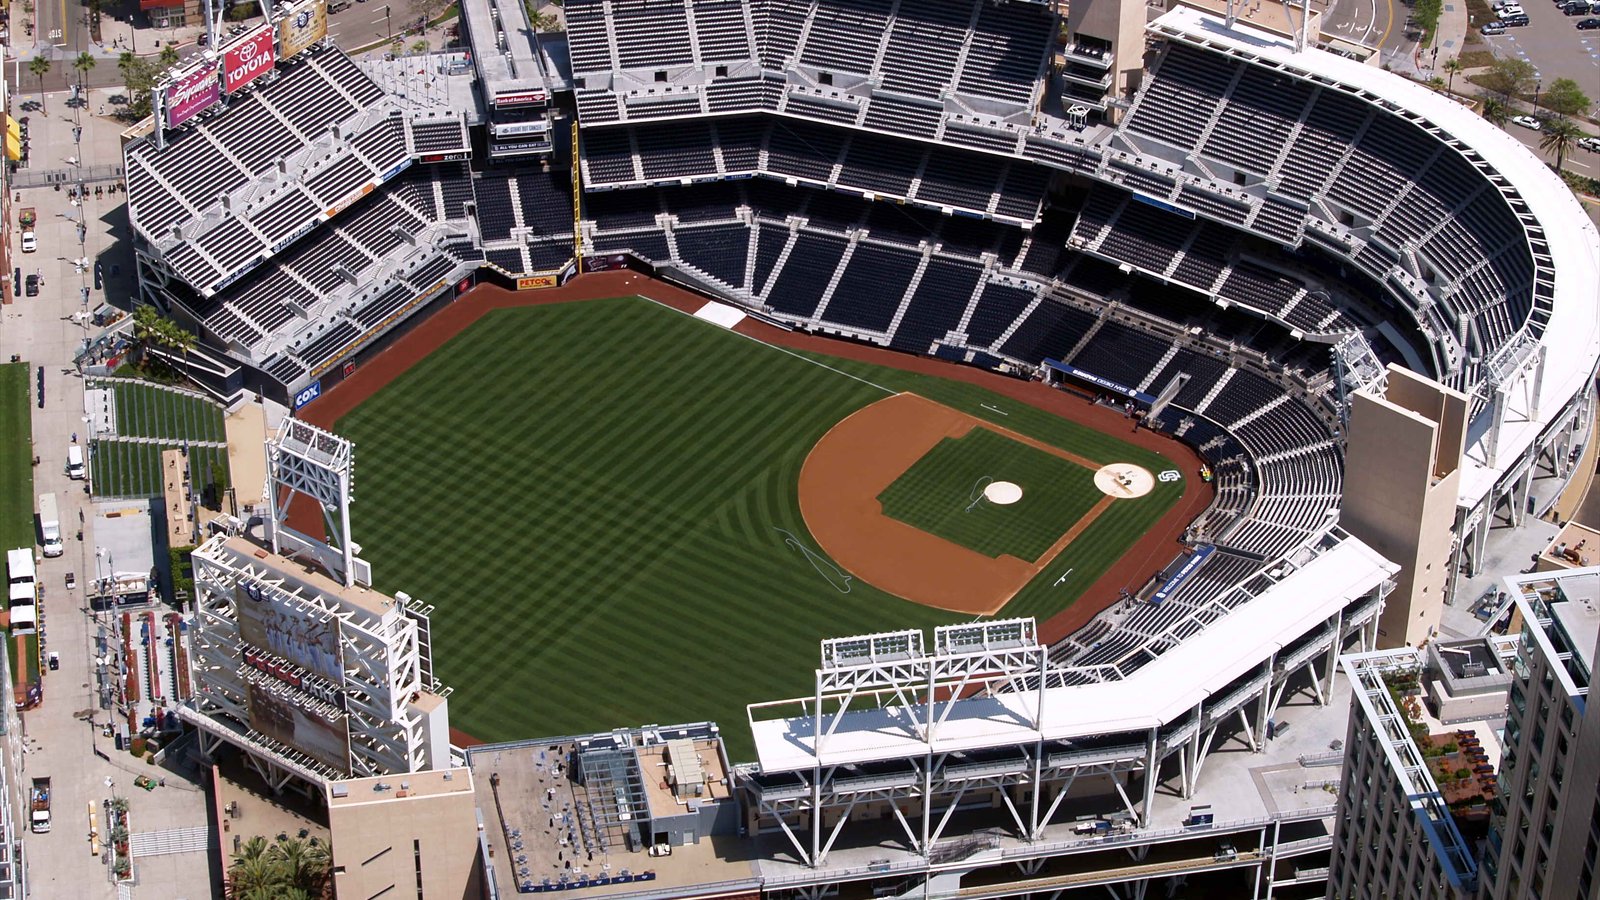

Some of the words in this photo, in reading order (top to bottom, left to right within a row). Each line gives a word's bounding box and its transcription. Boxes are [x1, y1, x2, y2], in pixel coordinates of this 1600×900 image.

[228, 51, 272, 84] TOYOTA
[1072, 369, 1097, 382] PADRES
[1097, 378, 1114, 388] DIEGO
[296, 384, 318, 406] COX
[1114, 384, 1128, 392] SAN
[246, 655, 300, 687] PETCO
[302, 677, 338, 706] PARK
